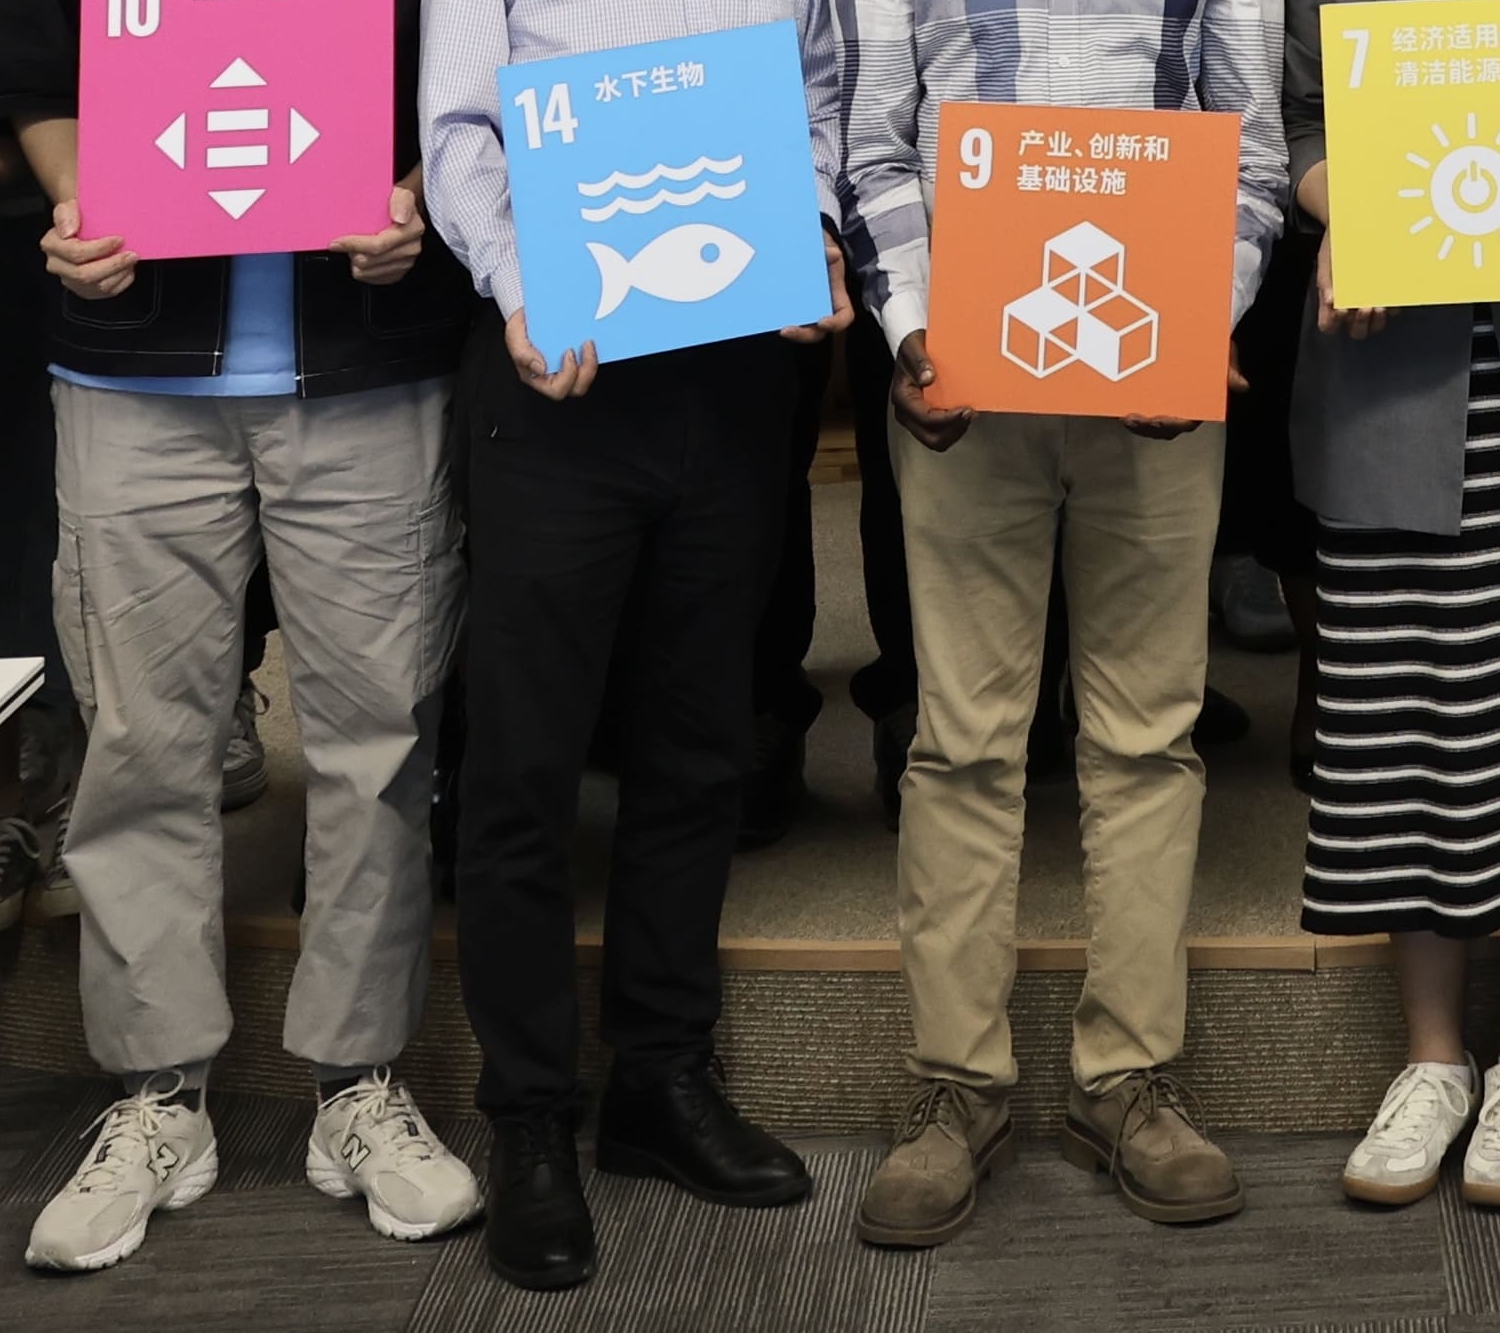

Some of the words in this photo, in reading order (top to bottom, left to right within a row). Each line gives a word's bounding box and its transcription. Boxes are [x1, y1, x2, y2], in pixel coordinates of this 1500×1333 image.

[1343, 29, 1369, 88] 7
[1397, 58, 1500, 85] 清洁能源
[595, 62, 704, 102] 水下生物
[515, 84, 578, 149] 14
[960, 129, 992, 188] 9
[1019, 130, 1168, 161] 产业、创新和
[1018, 165, 1126, 194] 基础设施
